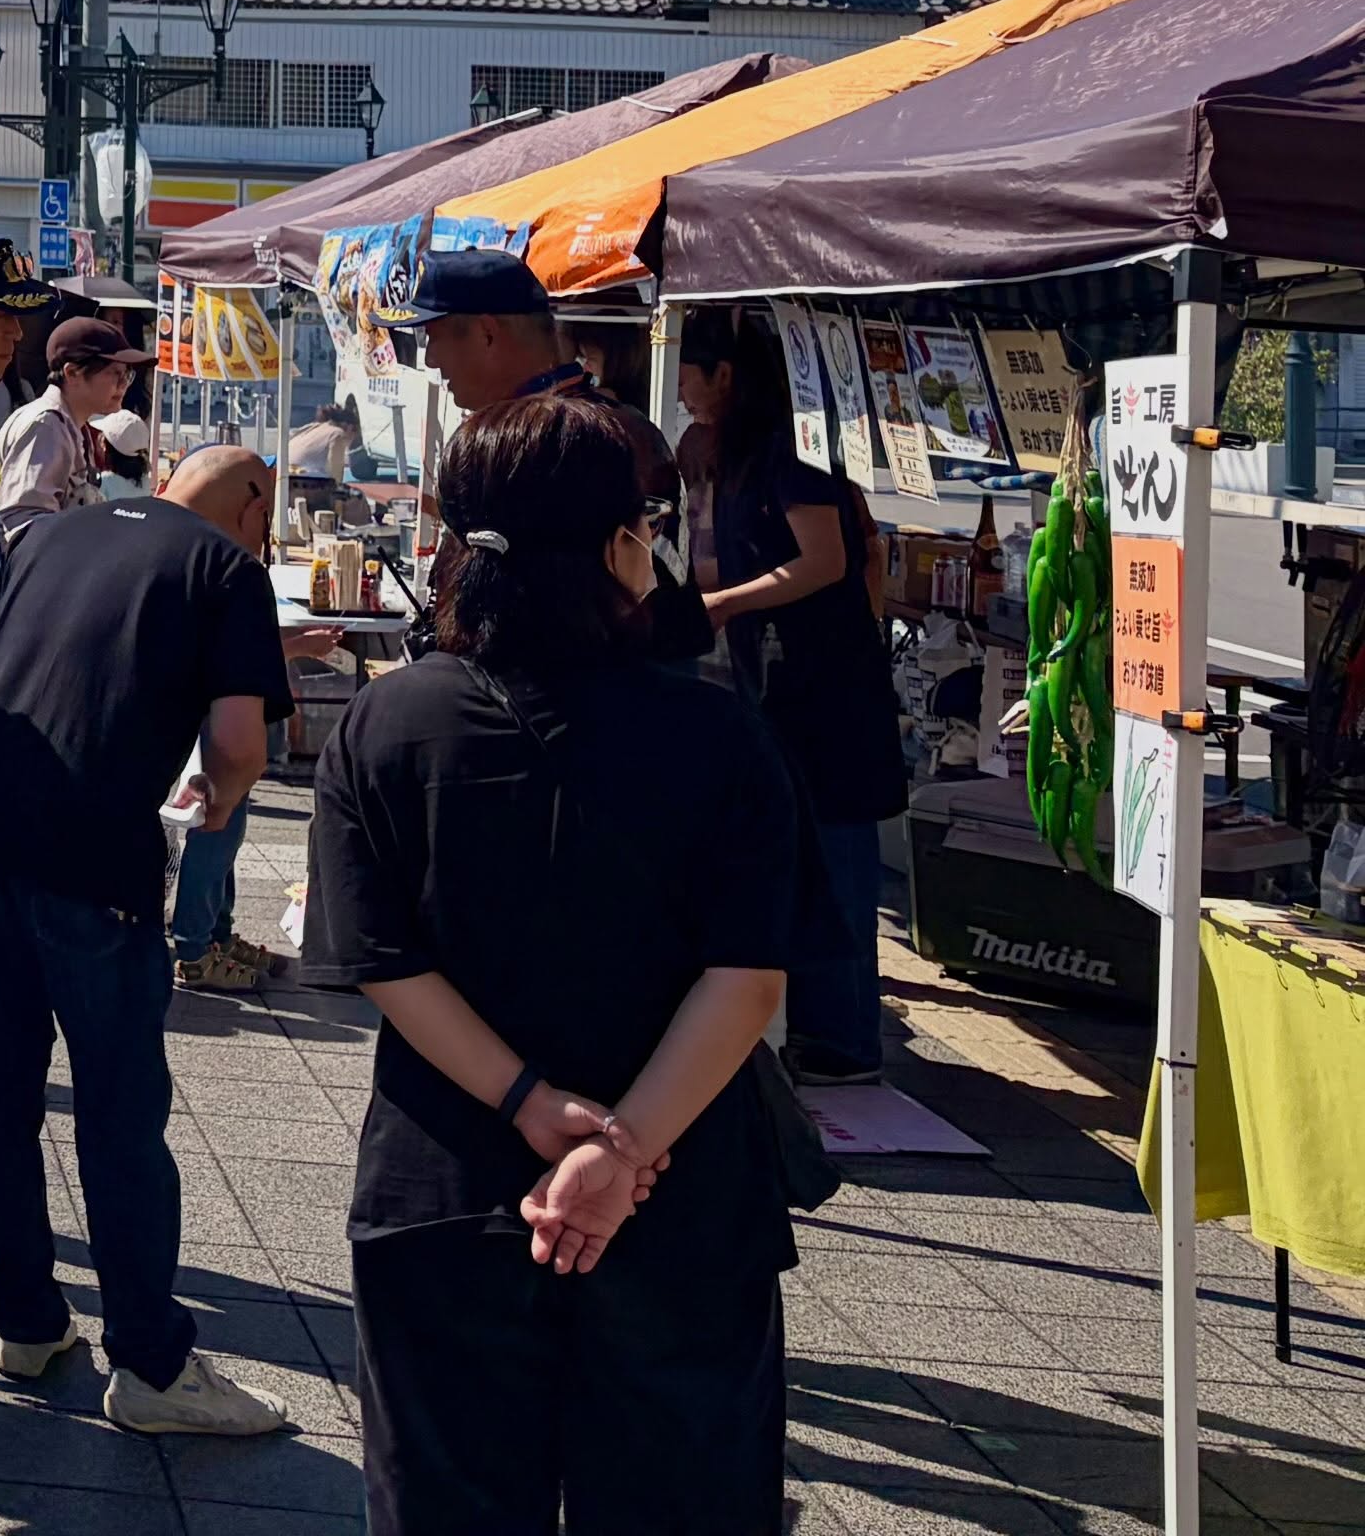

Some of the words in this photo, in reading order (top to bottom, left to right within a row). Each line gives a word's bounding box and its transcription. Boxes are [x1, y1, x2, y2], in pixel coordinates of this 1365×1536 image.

[1006, 350, 1044, 374] 無添加
[1129, 560, 1156, 593] 無添加
